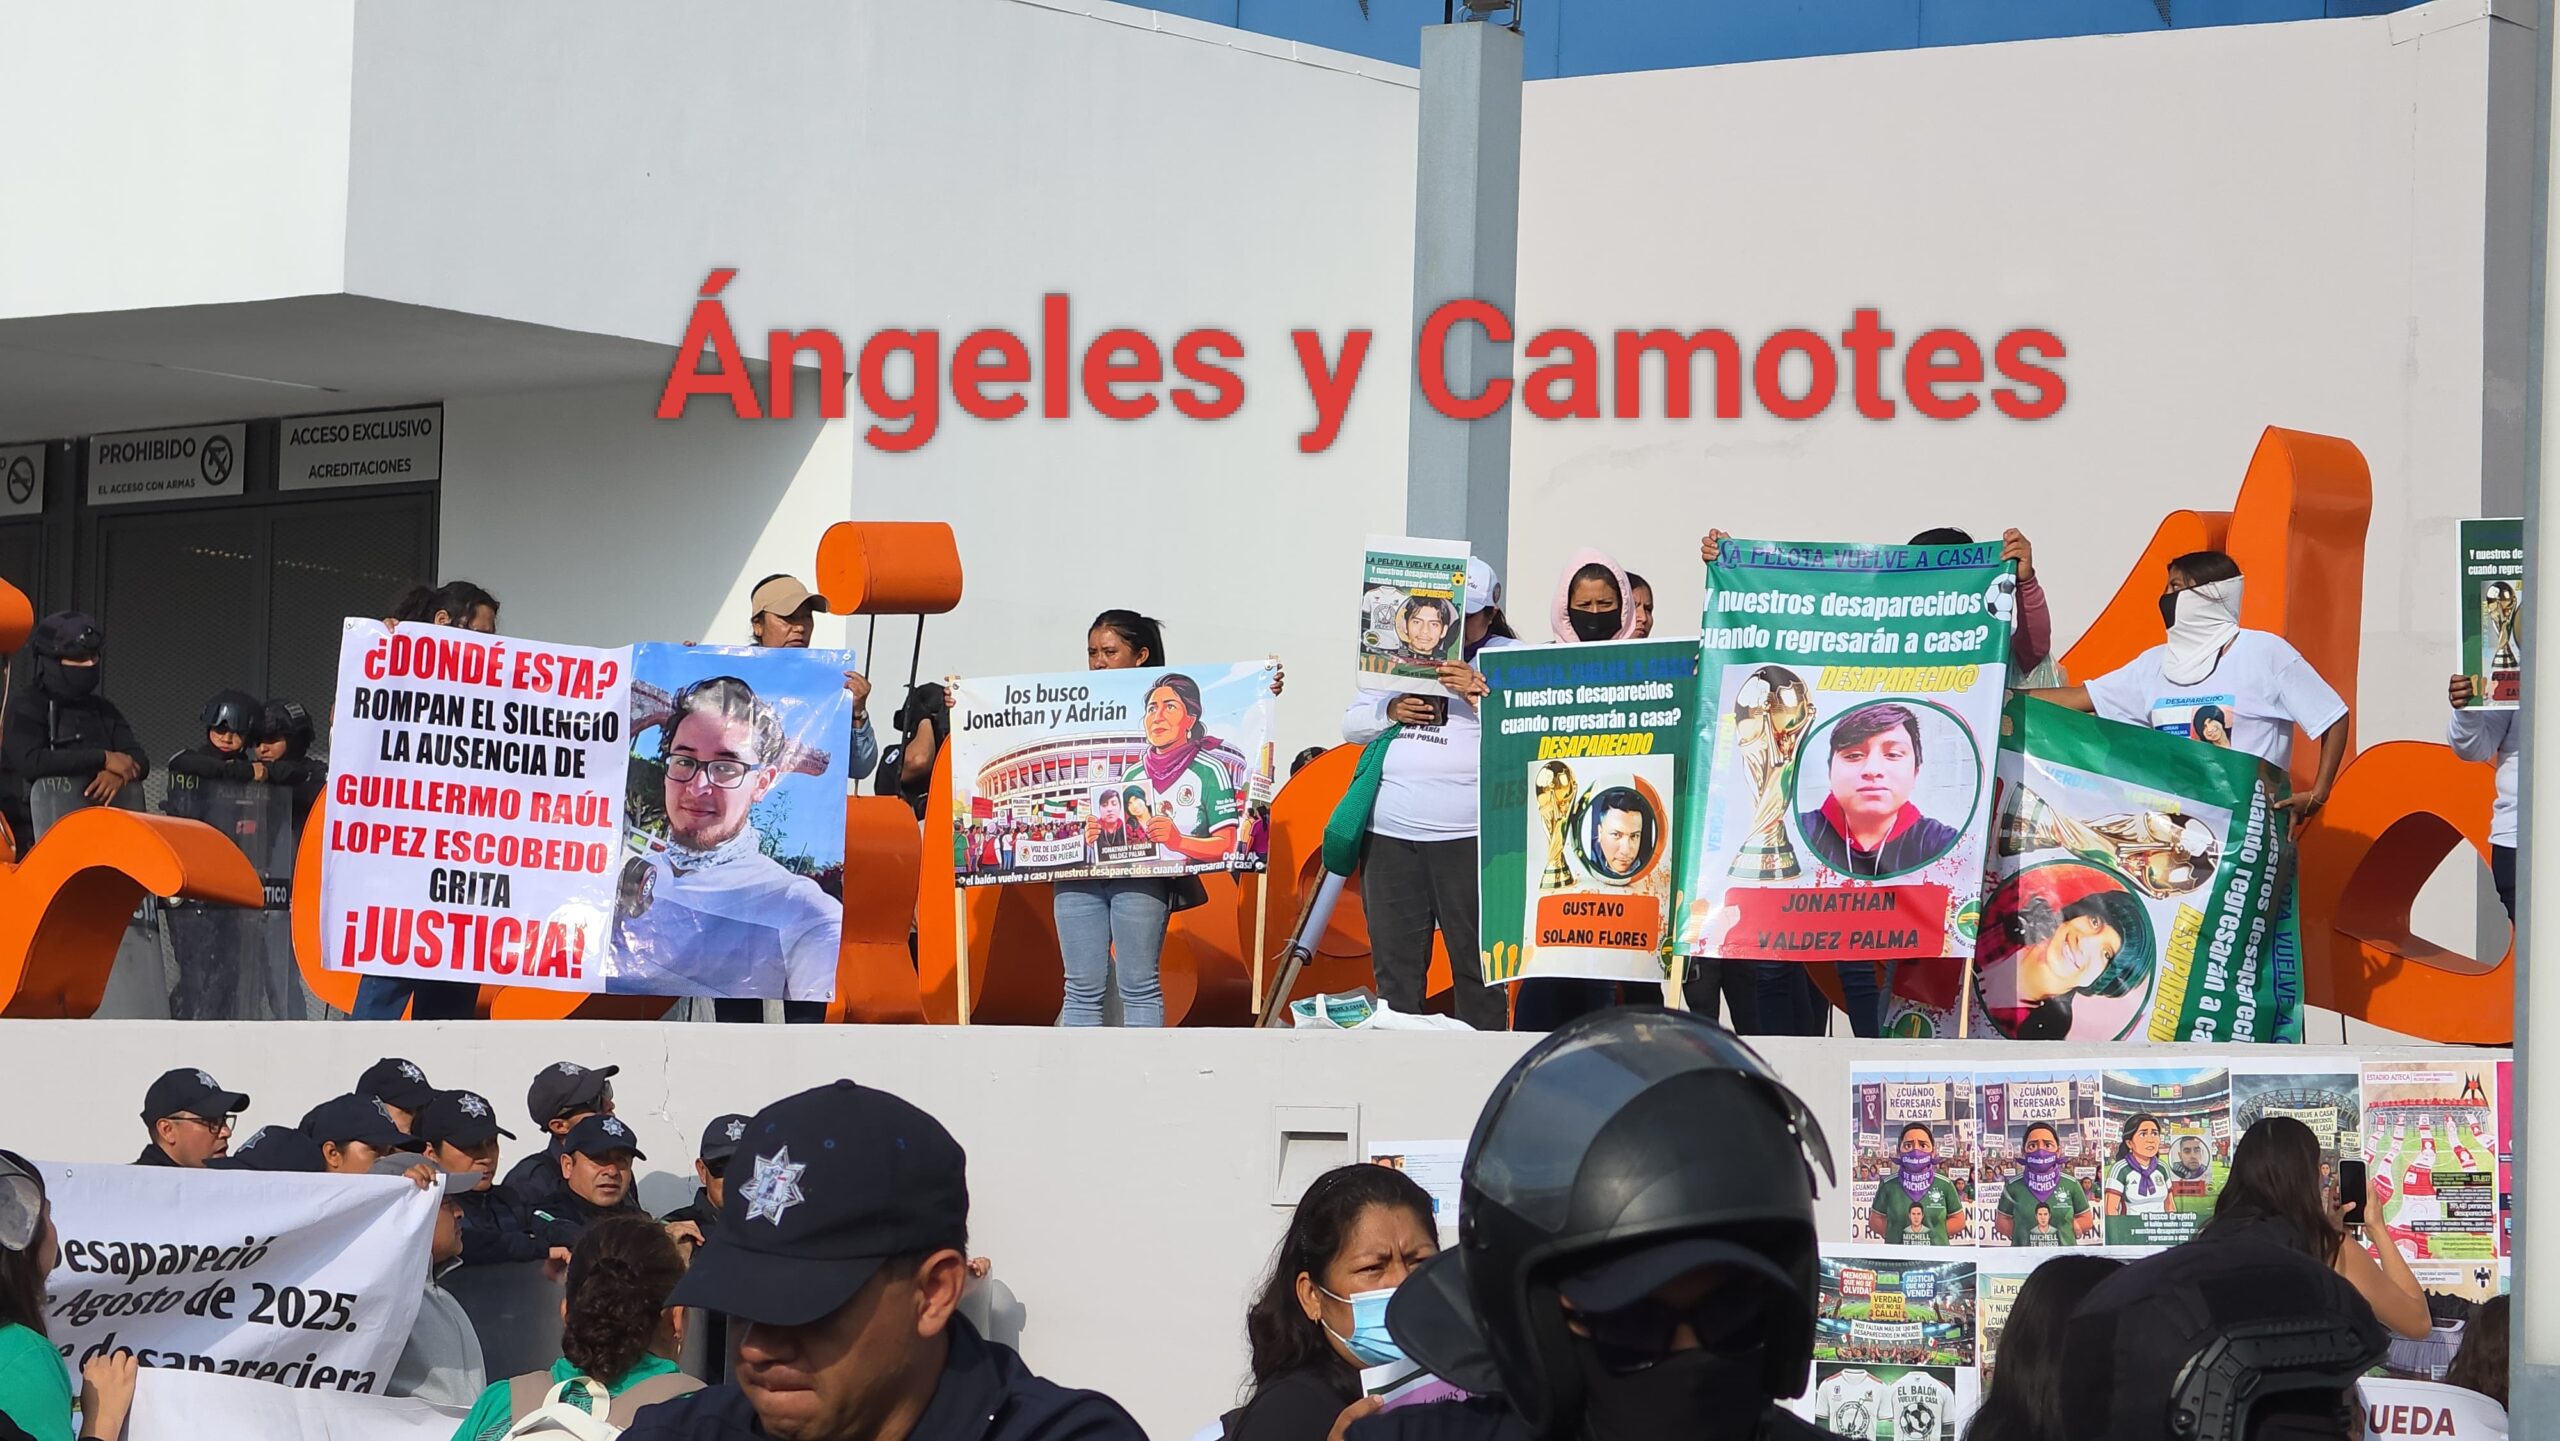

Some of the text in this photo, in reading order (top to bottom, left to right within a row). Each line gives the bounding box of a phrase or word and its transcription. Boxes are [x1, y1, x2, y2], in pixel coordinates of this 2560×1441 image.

[290, 418, 432, 446] ACCESO EXCLUSIVO
[99, 438, 196, 465] PROHIBIDO
[308, 458, 412, 479] ACREDITACIONES
[98, 478, 196, 495] EL ACCESO CON ARMAS
[1751, 546, 1824, 568] PELOTA
[1834, 548, 1909, 569] VUELVE
[1916, 551, 1928, 566] A
[1936, 546, 1993, 566] CASA!
[2470, 548, 2511, 560] Y nuestros
[1378, 558, 1403, 566] PELOTA
[1406, 561, 1432, 569] VUELVE
[2468, 564, 2497, 575] cuando
[1718, 588, 1815, 615] nuestros
[1821, 591, 1981, 621] desaparecidos
[1776, 627, 1899, 653] regresarán
[1904, 633, 1919, 653] a
[1924, 625, 1989, 652] casa?
[364, 634, 618, 702] ¿DONDÉ ESTA?
[1816, 663, 1980, 692] DESAPARECID@
[1005, 681, 1090, 705] los busco
[1504, 681, 1673, 708] Y nuestros desaparecidos
[2166, 695, 2224, 705] DESAPARECIDO
[352, 687, 620, 744] ROMPAN EL SILENCIO
[962, 700, 1128, 732] Jonathan y Adrián
[1501, 707, 1682, 735] cuando regresarán a casa?
[1416, 734, 1448, 745] POSADAS
[1537, 732, 1653, 759] DESAPARECIDO
[380, 729, 586, 779] LA AUSENCIA DE
[41, 776, 72, 793] 1973
[170, 774, 200, 790] 1961
[335, 774, 613, 829] GUILLERMO RAÚL
[331, 821, 609, 874] LOPEZ ESCOBEDO
[1031, 844, 1042, 853] VOZ
[1050, 844, 1061, 853] LOS
[1102, 844, 1128, 854] JONATHAN
[1032, 851, 1079, 863] CIDOS EN PUEBLA
[1109, 849, 1146, 861] VALDEZ PALMA
[1222, 852, 1246, 861] Dola
[2256, 809, 2280, 912] nuestros
[966, 877, 973, 885] el
[975, 873, 996, 885] balón
[998, 872, 1022, 884] vuelve
[1024, 873, 1029, 881] a
[1030, 871, 1047, 881] casa
[1048, 872, 1054, 882] y
[1055, 865, 1088, 879] nuestros
[1090, 863, 1152, 879] desaparecidos
[1152, 863, 1184, 875] cuando
[1185, 861, 1225, 874] regresaran
[1233, 860, 1253, 870] casa
[429, 867, 511, 909] GRITA
[1781, 892, 1896, 913] JONATHAN
[2199, 778, 2267, 1013] cuando regresarán a
[1562, 901, 1624, 917] GUSTAVO
[341, 905, 586, 980] ¡JUSTICIA!
[1543, 929, 1648, 947] SOLANO FLORES
[1757, 928, 1919, 951] VALDEZ PALMA
[2276, 931, 2297, 1008] VUELVE
[1896, 1086, 1935, 1098] ¿CUÁNDO
[2019, 1085, 2059, 1098] ¿CUÁNDO
[1890, 1097, 1942, 1108] REGRESARÁS
[2013, 1096, 2066, 1108] REGRESARÁS
[1899, 1109, 1933, 1118] A CASA?
[2023, 1108, 2057, 1118] A CASA?
[1903, 1171, 1931, 1181] TE BUSCO
[2029, 1171, 2056, 1181] TE BUSCO
[1903, 1180, 1931, 1192] MICHELL
[2029, 1180, 2057, 1192] MICHELL
[1842, 1271, 1874, 1281] MEMORIA
[1905, 1274, 1935, 1283] JUSTICIA
[1842, 1285, 1872, 1295] OLVIDA!
[1905, 1282, 1916, 1290] QUE
[1906, 1288, 1934, 1298] VENDE!
[51, 1278, 359, 1334] Agosto de 2025.
[1874, 1294, 1903, 1304] VERDAD
[1874, 1302, 1885, 1310] QUE
[1875, 1309, 1902, 1318] CALLA!
[1989, 1304, 1995, 1312] Y
[1854, 1328, 1892, 1338] DESAPARECIDOS
[1897, 1384, 1938, 1397] EL BALÓN
